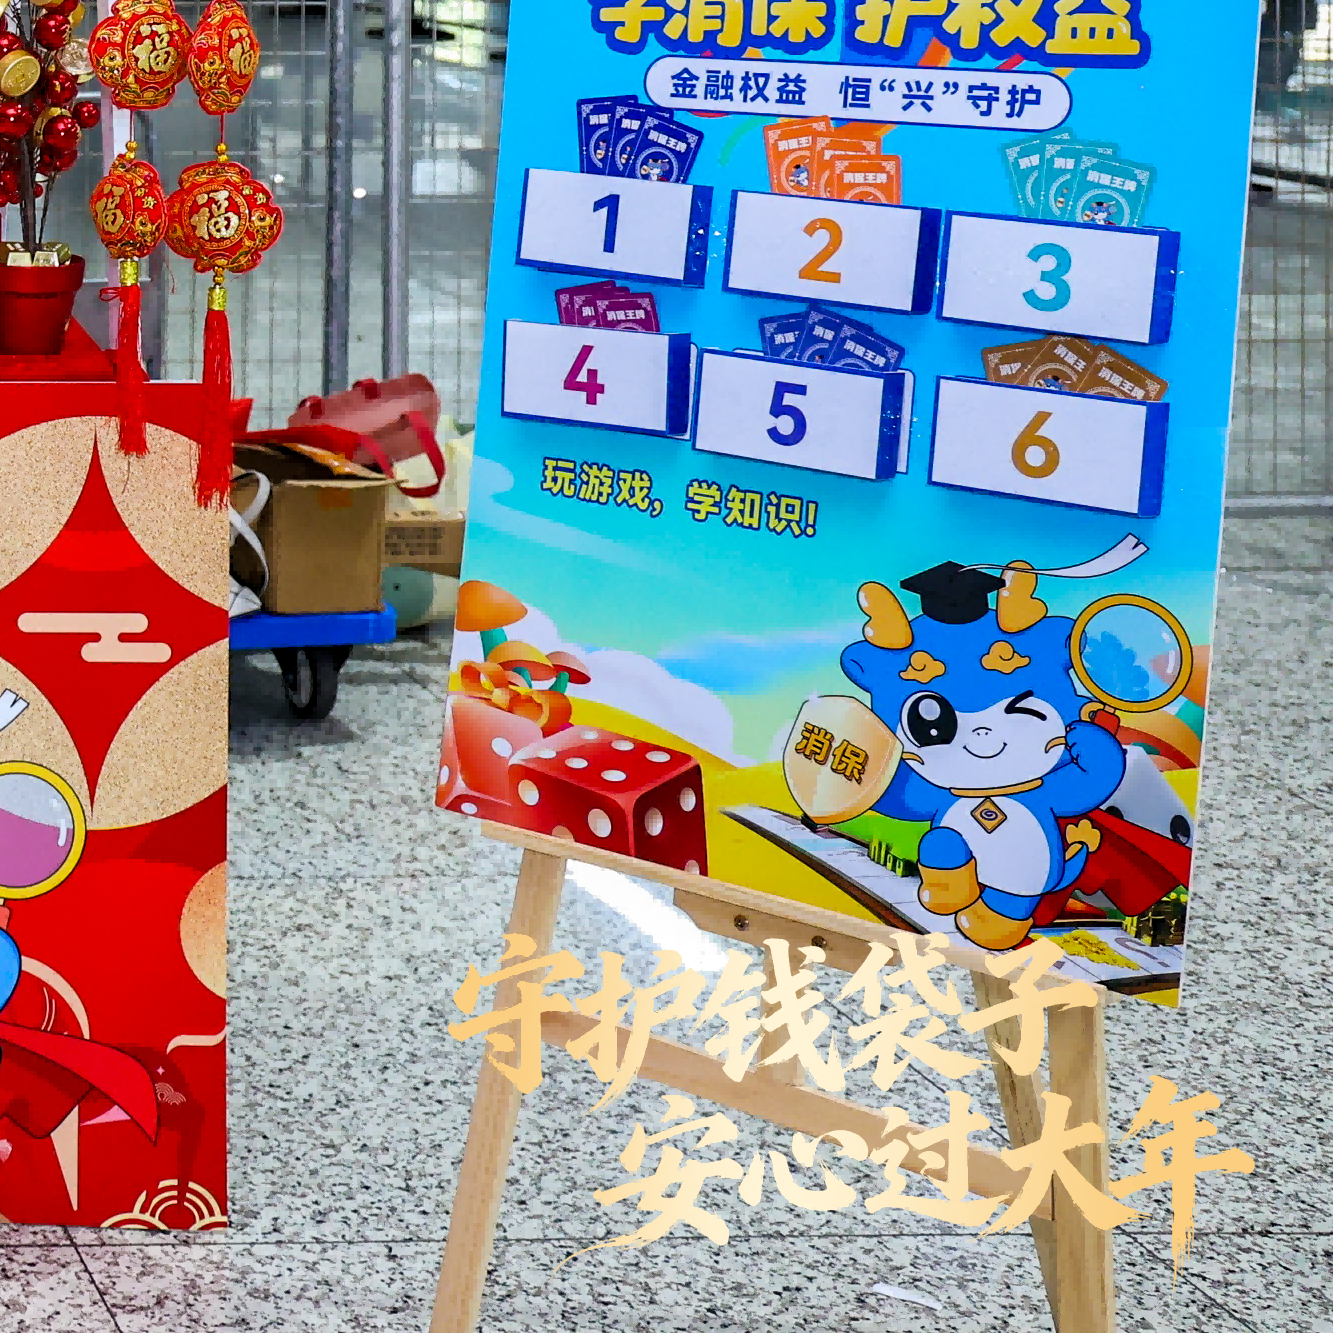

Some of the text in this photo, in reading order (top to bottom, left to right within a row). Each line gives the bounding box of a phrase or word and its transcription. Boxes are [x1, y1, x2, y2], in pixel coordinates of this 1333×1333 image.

[132, 23, 178, 73] 福
[229, 27, 255, 77] 福
[669, 70, 1043, 117] 金融权益 恒“兴”守护
[95, 183, 125, 234] 福
[190, 189, 240, 241] 福
[592, 193, 623, 254] 1
[797, 217, 844, 285] 2
[1021, 242, 1073, 313] 3
[562, 345, 606, 405] 4
[766, 381, 808, 447] 5
[1011, 410, 1061, 479] 6
[793, 721, 870, 785] 消保
